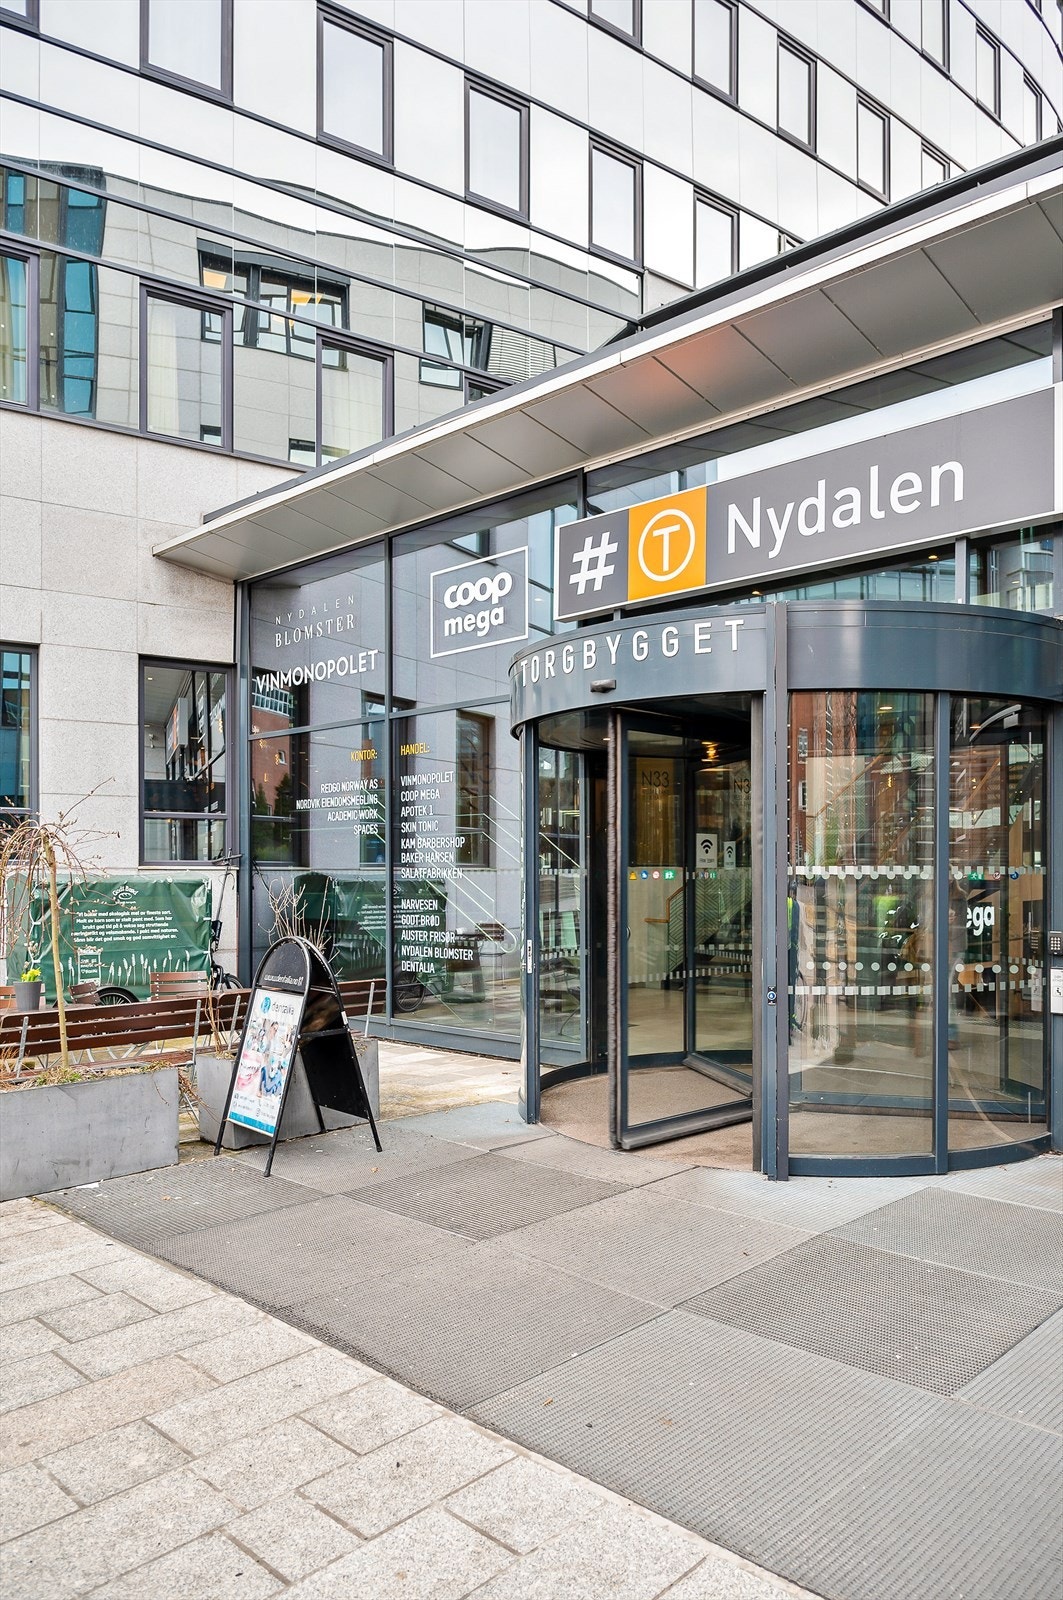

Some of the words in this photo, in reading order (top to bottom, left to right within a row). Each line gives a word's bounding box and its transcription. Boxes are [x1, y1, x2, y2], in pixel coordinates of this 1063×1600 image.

[727, 459, 964, 559] Nydalen
[444, 571, 513, 610] coop
[274, 594, 355, 626] NYDALEN
[444, 606, 504, 637] mega
[274, 613, 355, 648] BLOMSTER
[520, 618, 744, 687] TORGBYGGET
[256, 648, 378, 693] VINMONOPOLET
[350, 748, 378, 762] KONTOR:
[400, 742, 430, 756] HANDEL:
[341, 779, 368, 792] NORWAY
[369, 778, 378, 790] AS
[400, 771, 454, 787] VINMONOPOLET
[641, 770, 669, 788] N33
[733, 778, 752, 794] N3
[296, 798, 320, 810] NORDVIK
[321, 794, 378, 808] EIENDOMSMEGLING
[400, 790, 419, 802] COOP
[420, 788, 440, 800] MEGA
[327, 810, 358, 822] ACADEMIC
[359, 808, 378, 820] WORK
[400, 805, 428, 817] APOTEK
[428, 804, 433, 816] 1
[353, 823, 378, 835] SPACES
[401, 821, 417, 833] SKIN
[418, 820, 439, 832] TONIC
[401, 838, 416, 850] KAM
[417, 836, 465, 849] BARBERSHOP
[401, 852, 424, 863] BAKER
[425, 851, 454, 863] HANSEN
[401, 867, 463, 879] SALATFABRIKKEN
[401, 899, 438, 911] NARVESEN
[401, 915, 419, 926] GODT
[420, 915, 440, 928] BRØD
[966, 905, 995, 936] ega
[401, 930, 428, 942] AUSTER
[429, 930, 456, 944] FRISØR
[401, 945, 433, 958] NYDALEN
[434, 946, 473, 961] BLOMSTER
[401, 959, 435, 974] DENTALIA
